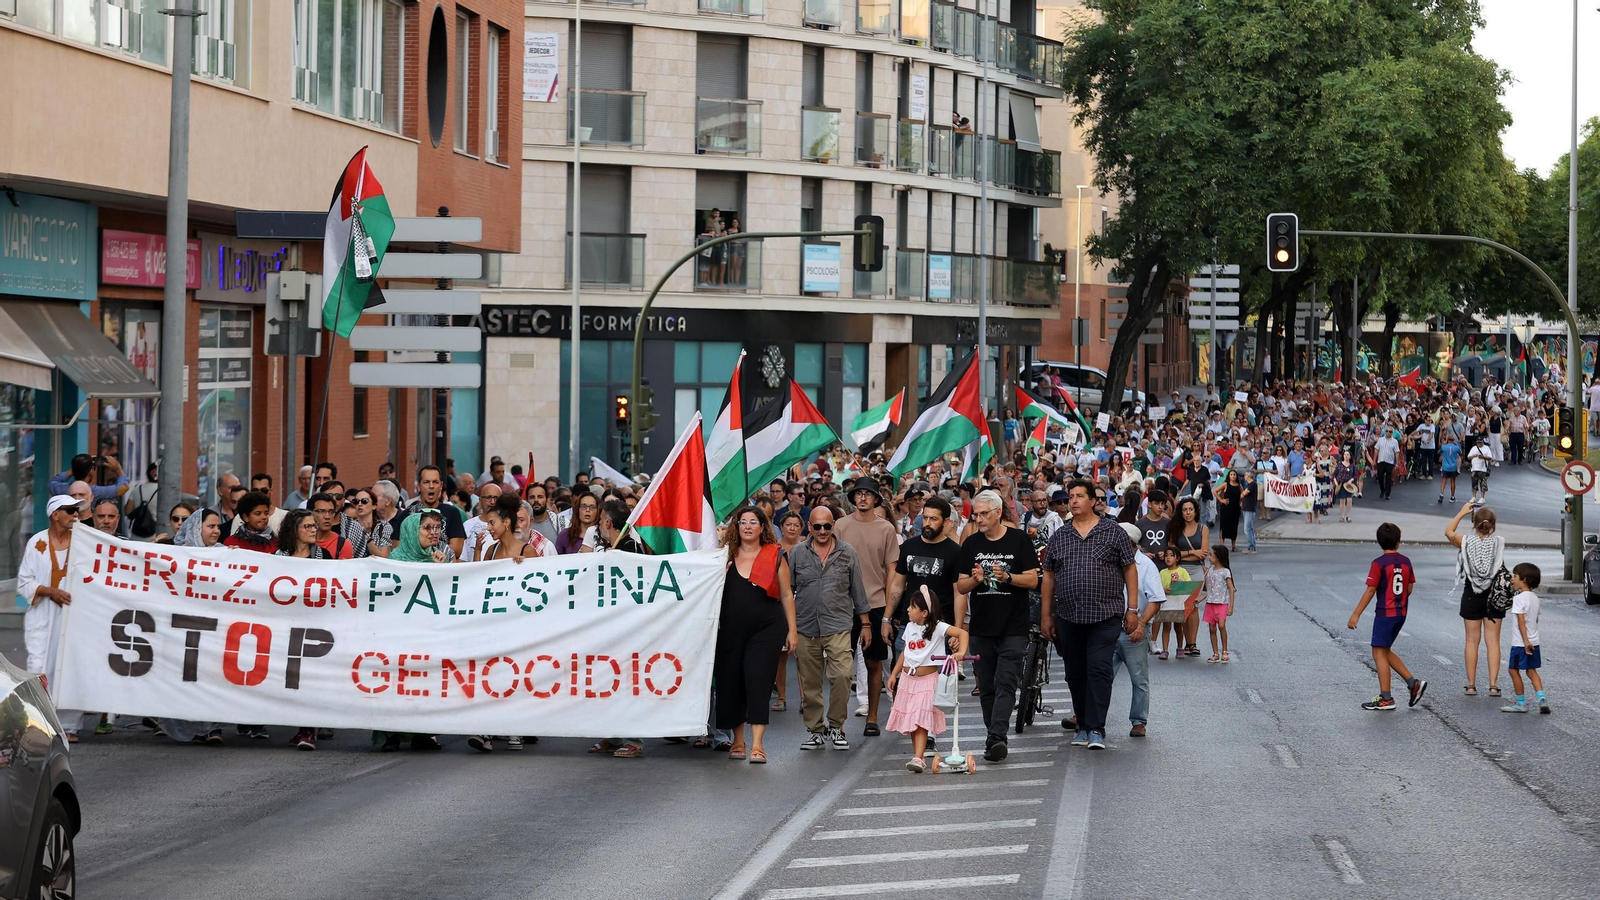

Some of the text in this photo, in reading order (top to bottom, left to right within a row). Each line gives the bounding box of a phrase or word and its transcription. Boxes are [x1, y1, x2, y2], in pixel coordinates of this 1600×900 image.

[806, 265, 839, 276] PSICOLOGÍA
[560, 313, 687, 333] IFORMTICA
[83, 543, 684, 615] JEREZ CON PALESTINA
[1392, 573, 1403, 595] 6
[108, 609, 683, 699] STOP GENOCIDIO
